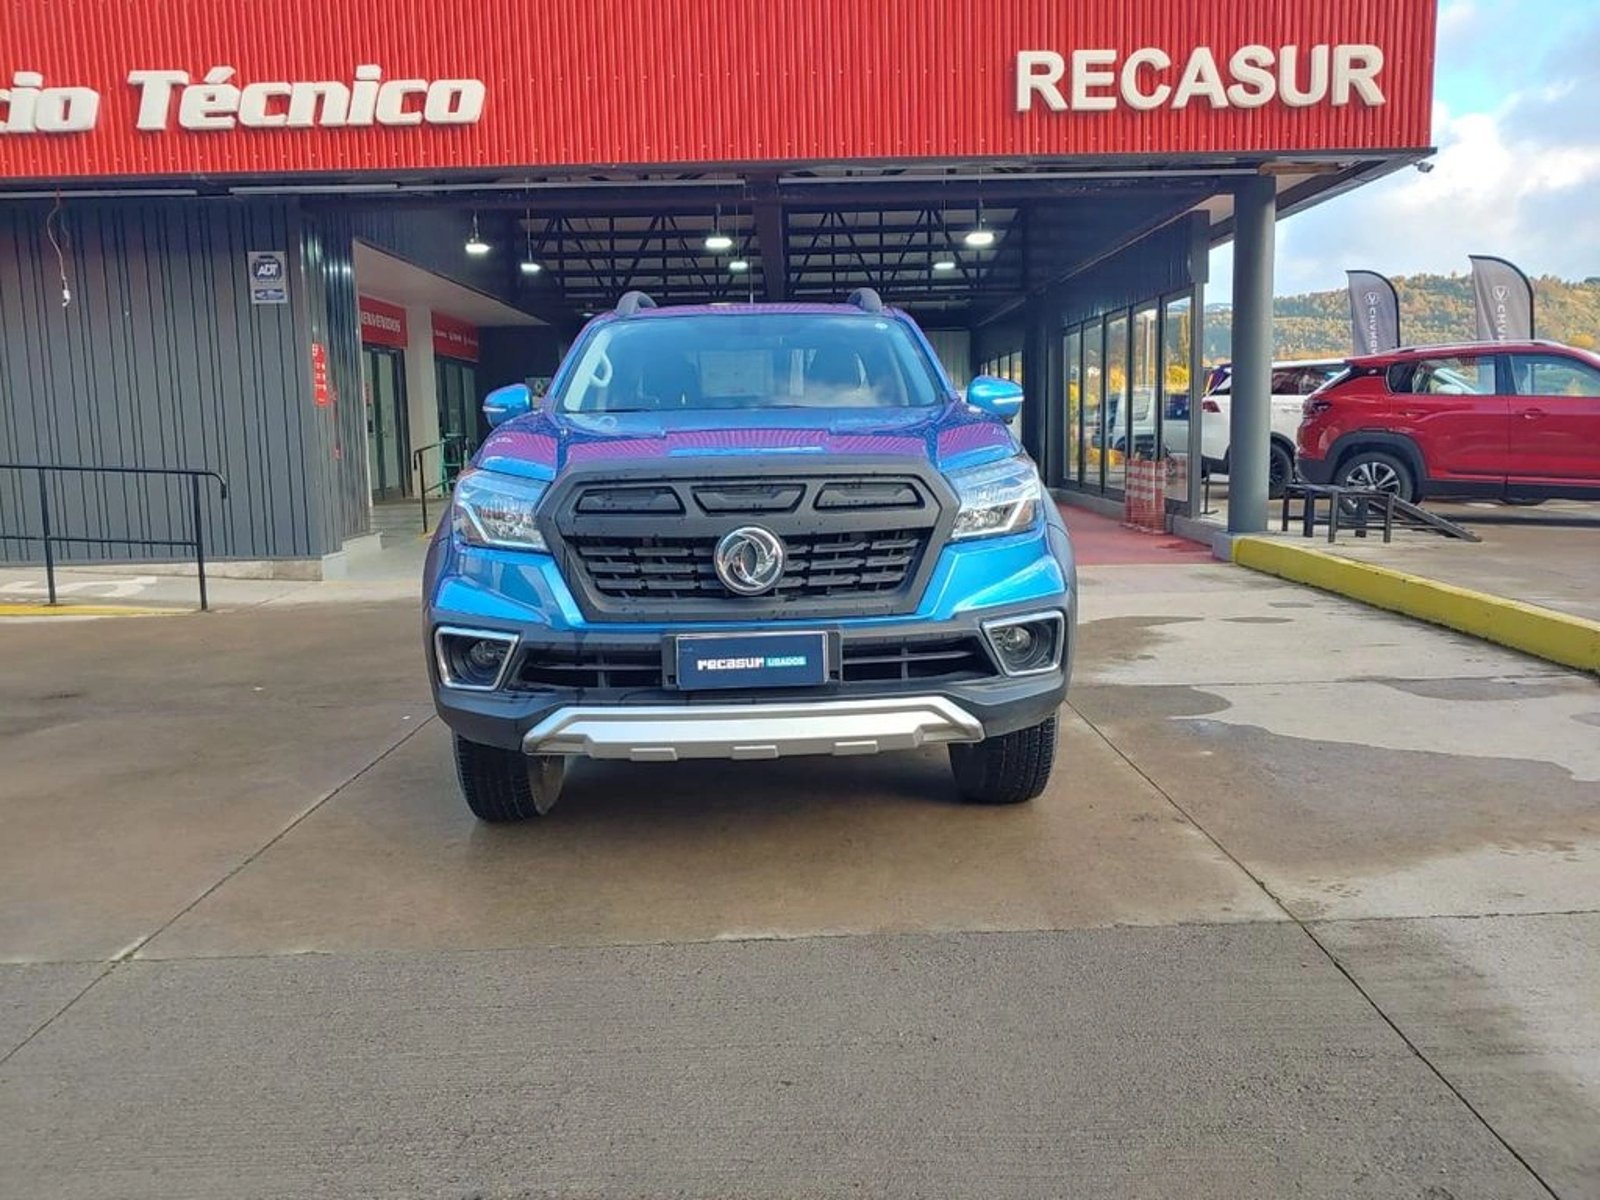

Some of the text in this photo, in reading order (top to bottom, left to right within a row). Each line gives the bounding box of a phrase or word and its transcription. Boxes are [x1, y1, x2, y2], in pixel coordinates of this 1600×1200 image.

[0, 64, 486, 132] io Técnico
[1016, 44, 1386, 112] RECASUR
[257, 263, 279, 276] ADT
[697, 656, 807, 671] recasur USADOS
